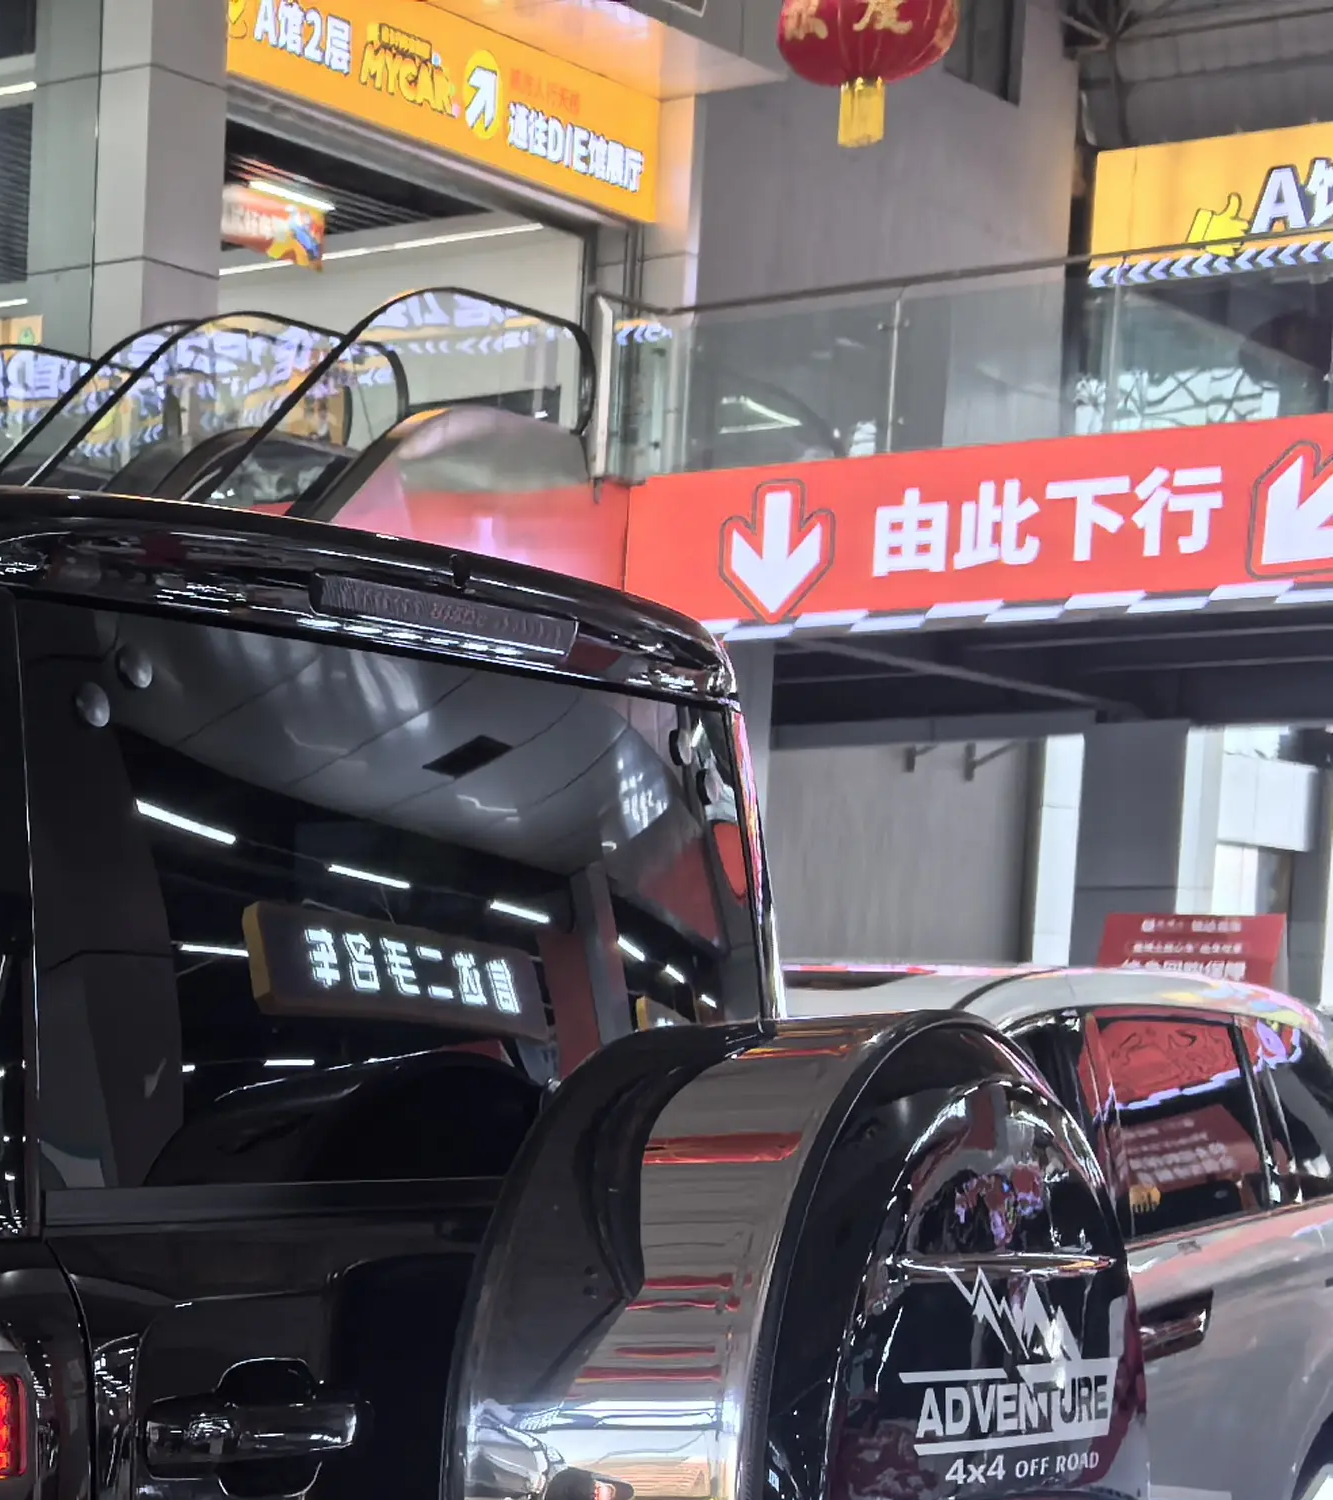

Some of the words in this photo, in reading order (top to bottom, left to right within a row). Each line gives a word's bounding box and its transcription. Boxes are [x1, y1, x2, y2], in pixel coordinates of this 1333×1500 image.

[872, 466, 1224, 577] 由此下行
[916, 1373, 1110, 1439] ADVENTURE
[945, 1454, 1006, 1485] 4x4
[1015, 1458, 1052, 1479] OFF
[1055, 1450, 1100, 1474] ROAD
